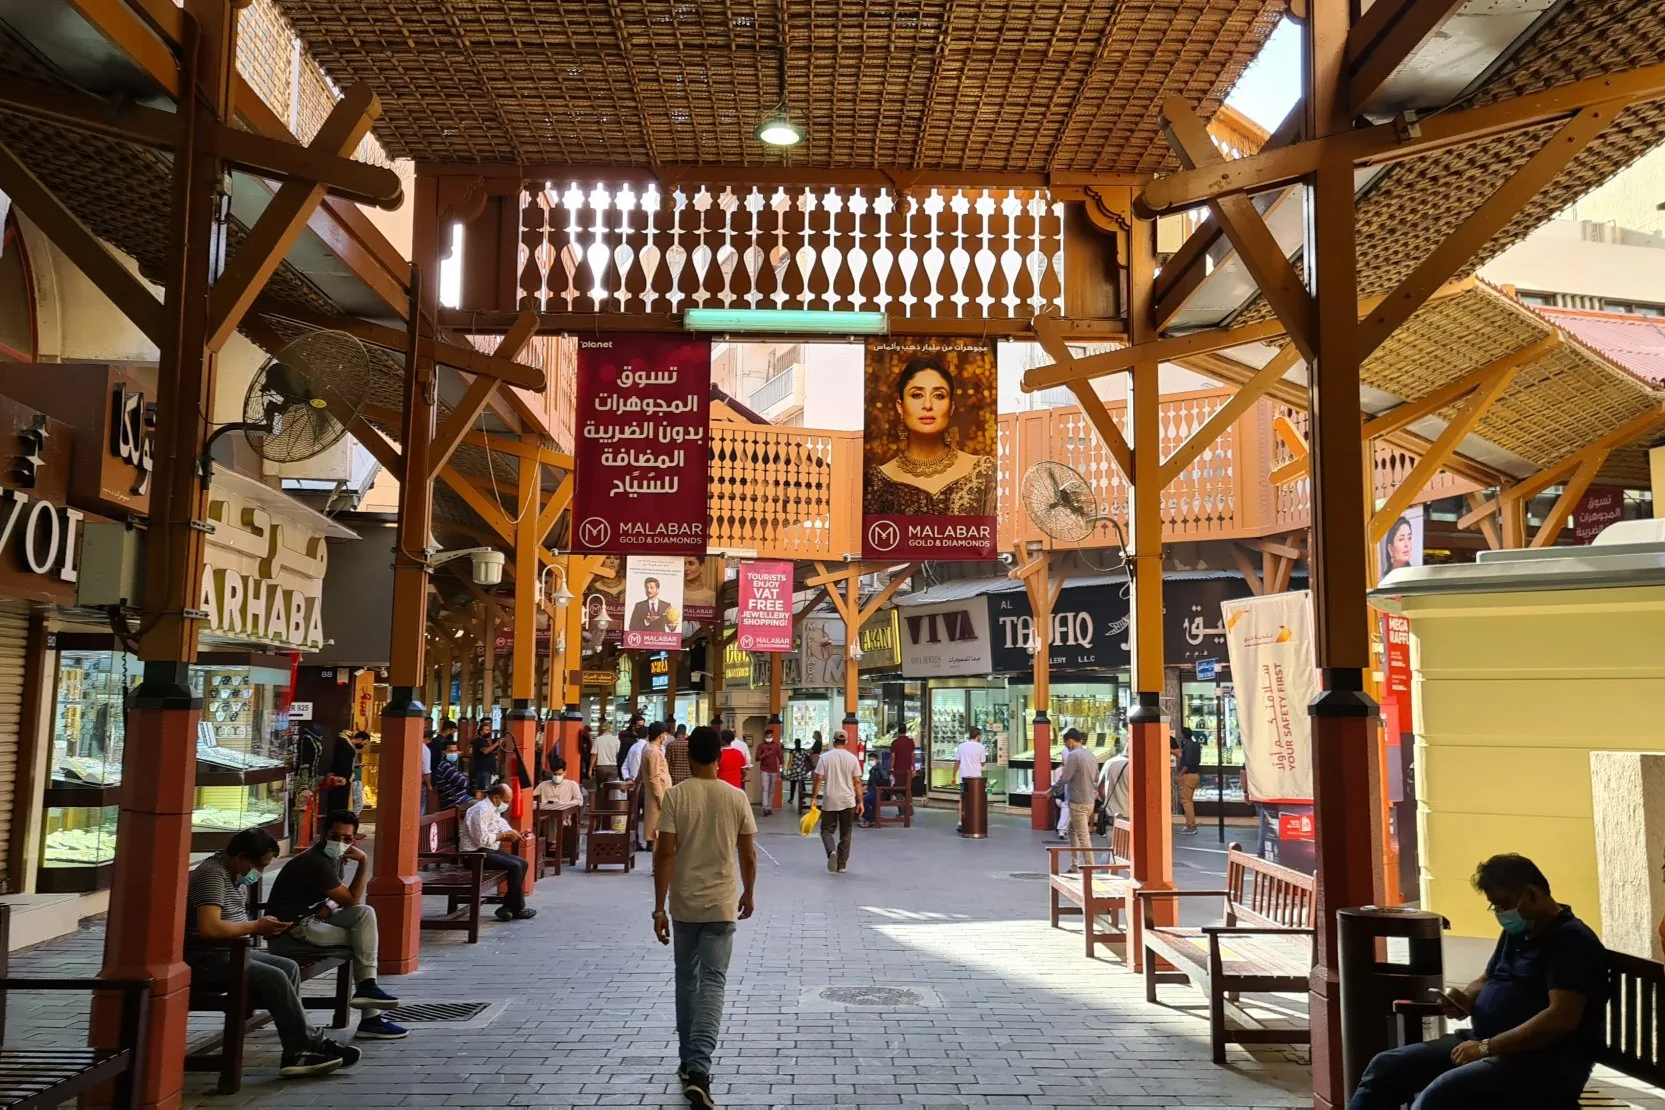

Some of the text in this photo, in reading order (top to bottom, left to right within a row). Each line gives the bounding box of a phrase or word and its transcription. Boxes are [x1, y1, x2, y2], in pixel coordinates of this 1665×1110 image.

[581, 341, 613, 349] planet
[901, 344, 920, 352] ذهب
[941, 344, 954, 352] من
[954, 343, 988, 352] مجوهرات
[617, 366, 678, 388] تسوق
[594, 393, 698, 416] المجوهرات
[583, 420, 704, 444] بدون الضريبة
[601, 448, 685, 469] المضافة
[1586, 494, 1612, 510] تسوق
[1579, 507, 1621, 523] المجوهرات
[619, 522, 702, 535] MALABAR
[908, 525, 990, 538] MALABAR
[619, 536, 702, 545] GOLD & DIAMONDS
[908, 539, 990, 548] GOLD & DIAMONDS
[747, 573, 787, 582] TOURISTS
[753, 580, 780, 588] ENJOY
[753, 588, 780, 600] VAT
[748, 599, 784, 611] FREE
[1000, 600, 1013, 610] AL
[741, 611, 791, 620] JEWELLERY
[743, 618, 788, 627] SHOPPING!
[903, 610, 979, 645] VIVA
[643, 635, 677, 643] MALABAR
[756, 637, 790, 645] MALABAR
[321, 670, 333, 678] 88
[1273, 662, 1297, 772] YOUR SAFETY FIRST
